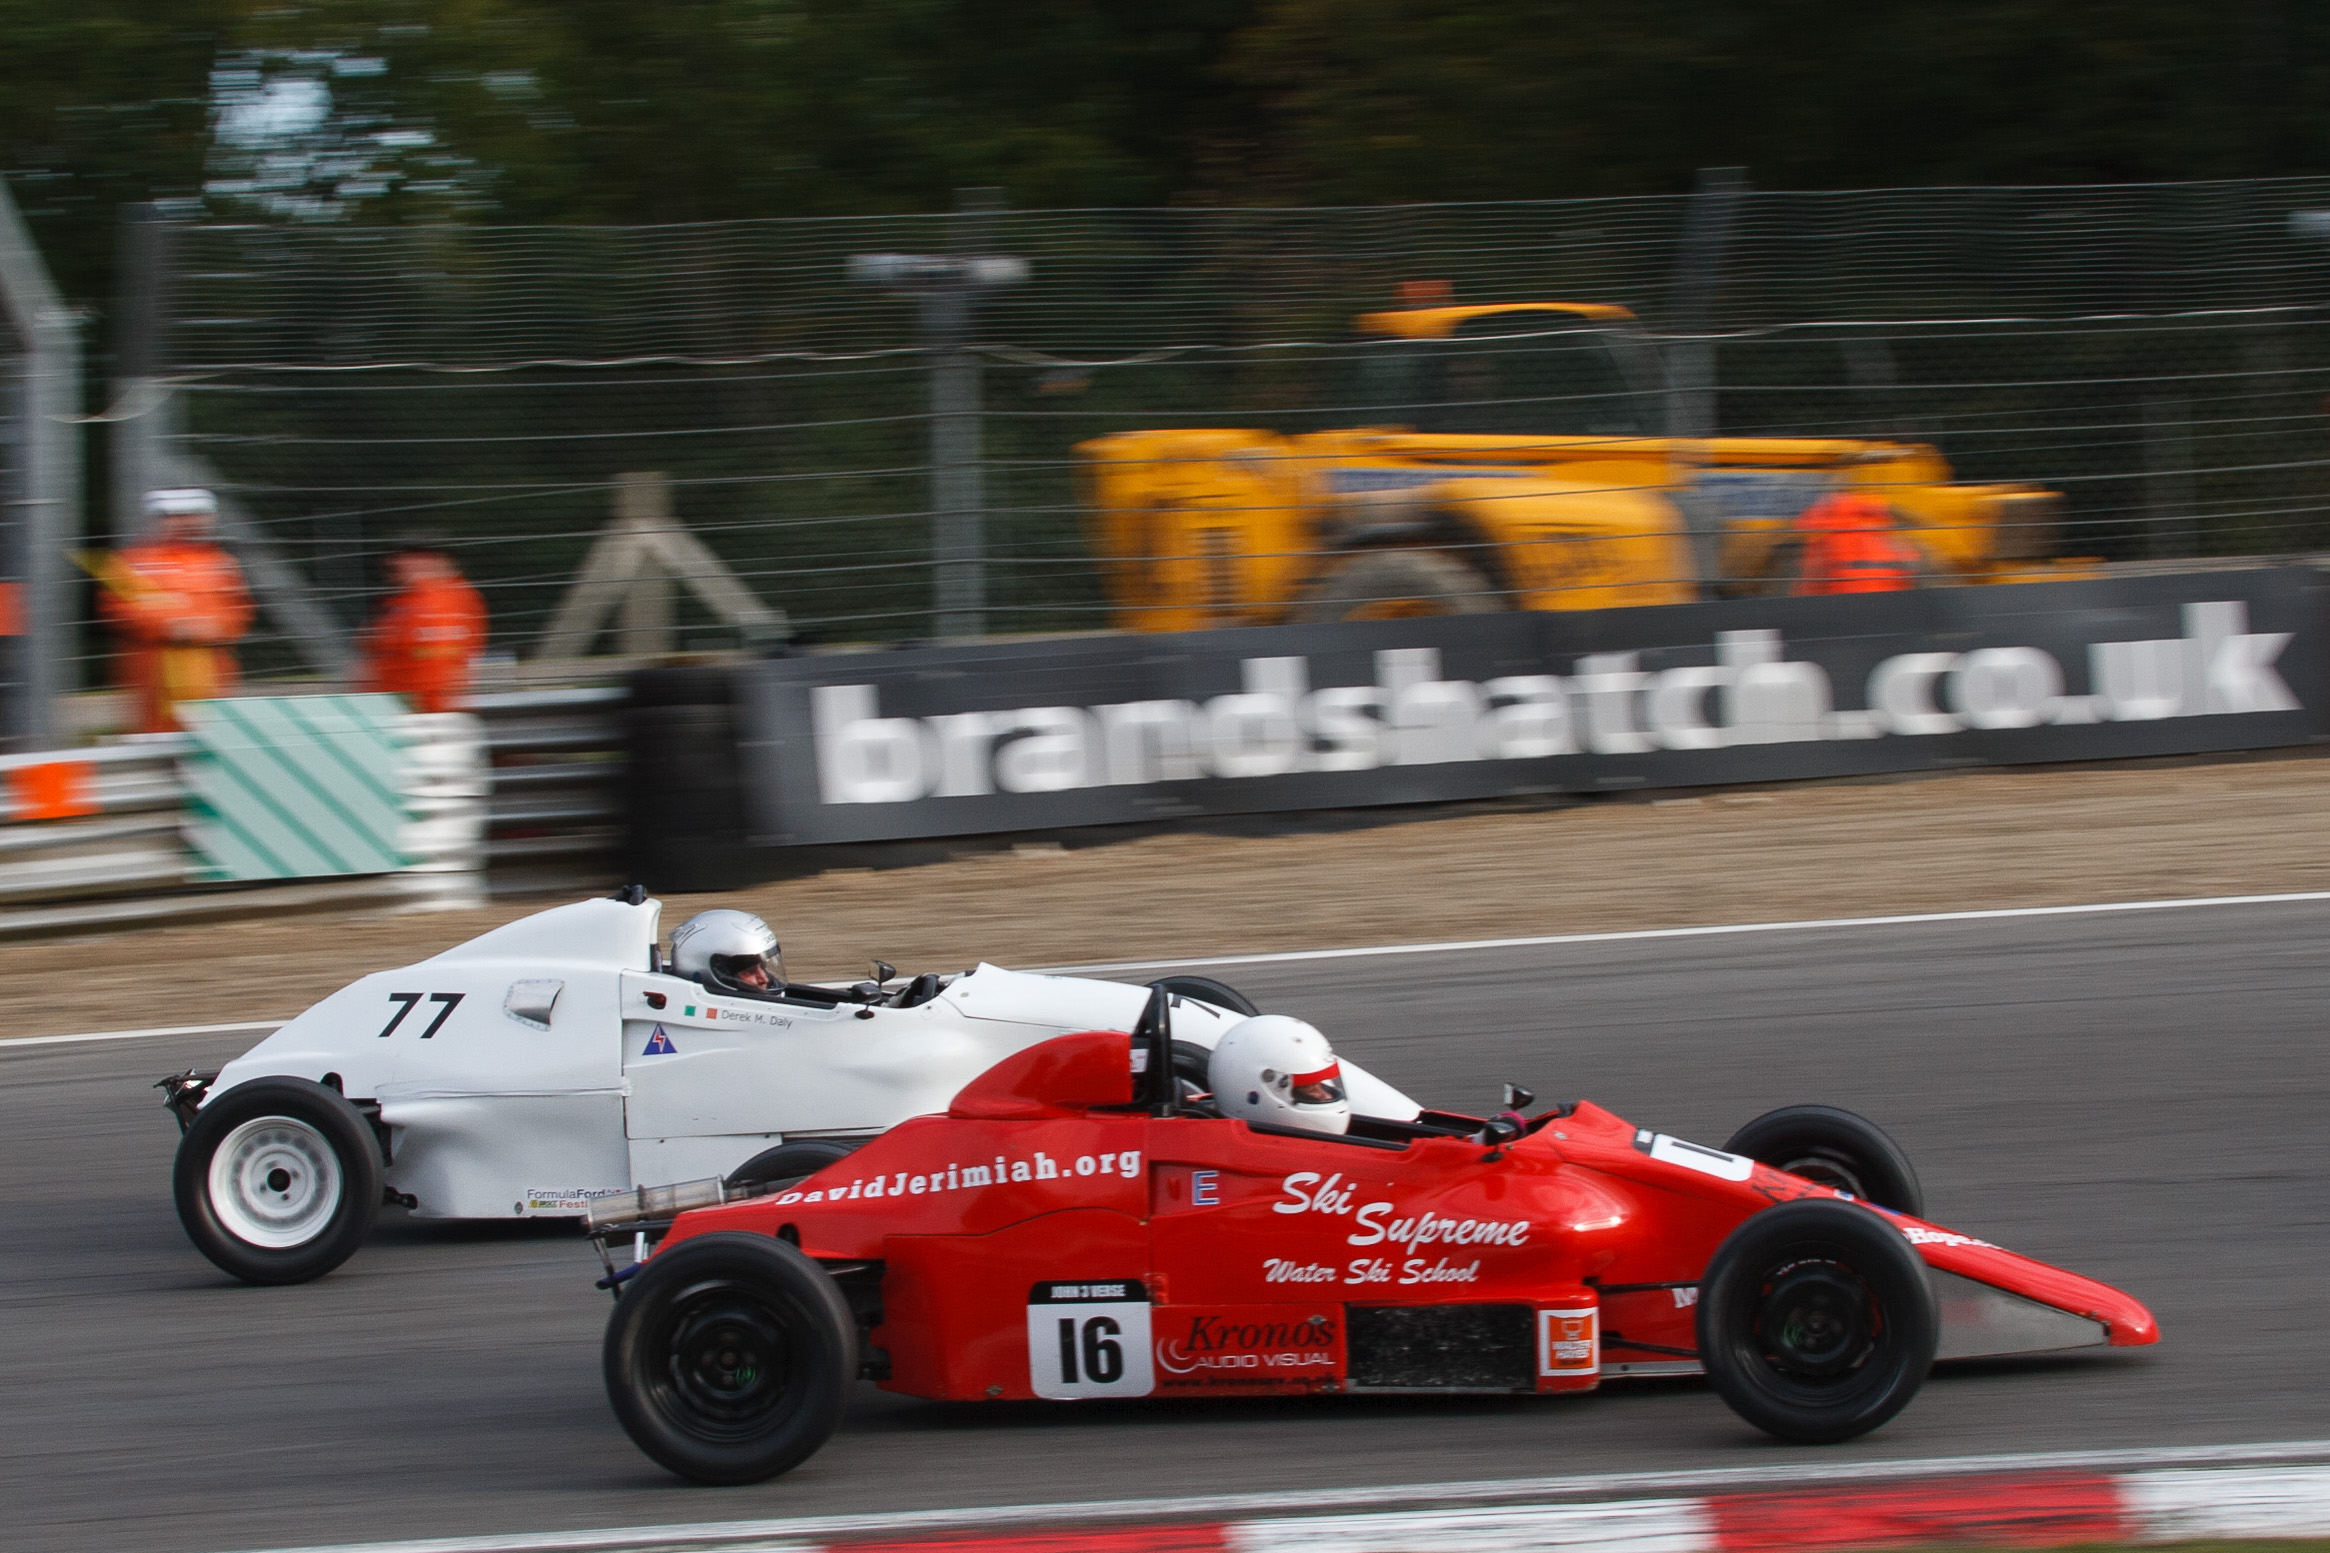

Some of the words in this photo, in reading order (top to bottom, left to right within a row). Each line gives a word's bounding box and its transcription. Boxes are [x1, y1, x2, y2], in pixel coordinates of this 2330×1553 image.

[810, 600, 2301, 804] brandshatch.co.uk
[378, 992, 467, 1039] 77
[721, 1010, 751, 1022] Derek
[754, 1014, 766, 1025] M.
[769, 1016, 793, 1030] Daly
[775, 1149, 1142, 1206] DavidJerimiah.org
[1272, 1172, 1357, 1215] Ski
[1347, 1201, 1531, 1256] Supreme
[1263, 1258, 1338, 1283] Water
[1344, 1257, 1393, 1285] Ski
[1398, 1257, 1481, 1285] School
[1058, 1316, 1124, 1384] 16
[1182, 1316, 1337, 1351] Kronos
[1197, 1354, 1259, 1368] AUDIO
[1262, 1352, 1336, 1367] VISUAL
